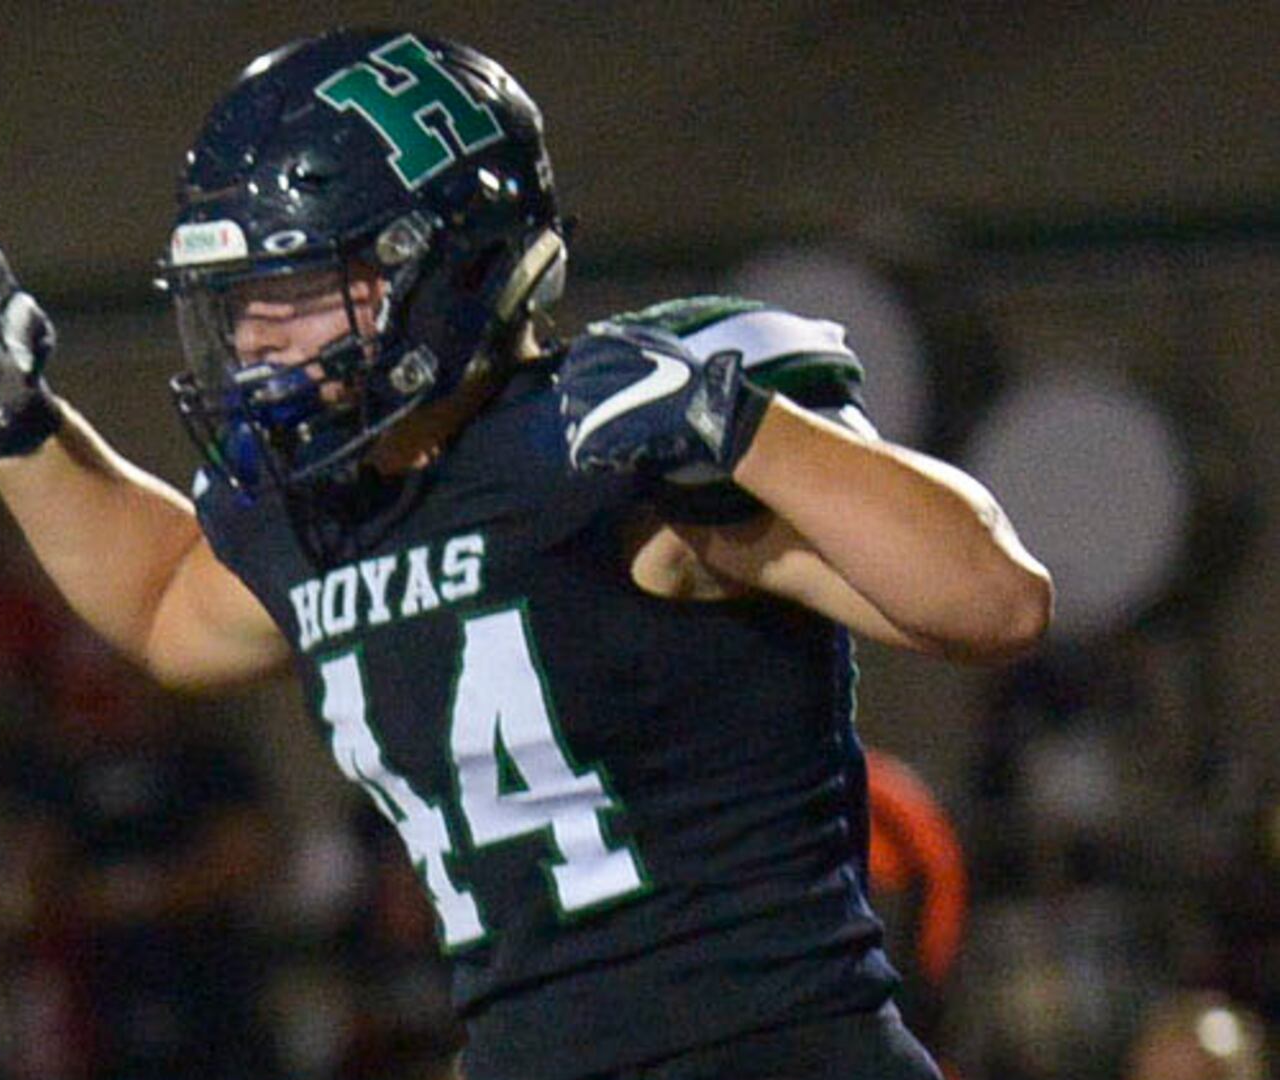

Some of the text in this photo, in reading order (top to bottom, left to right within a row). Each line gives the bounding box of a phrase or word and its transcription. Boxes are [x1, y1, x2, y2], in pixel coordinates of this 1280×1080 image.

[314, 33, 505, 191] H
[289, 534, 486, 650] HOYAS
[316, 600, 648, 952] 44
